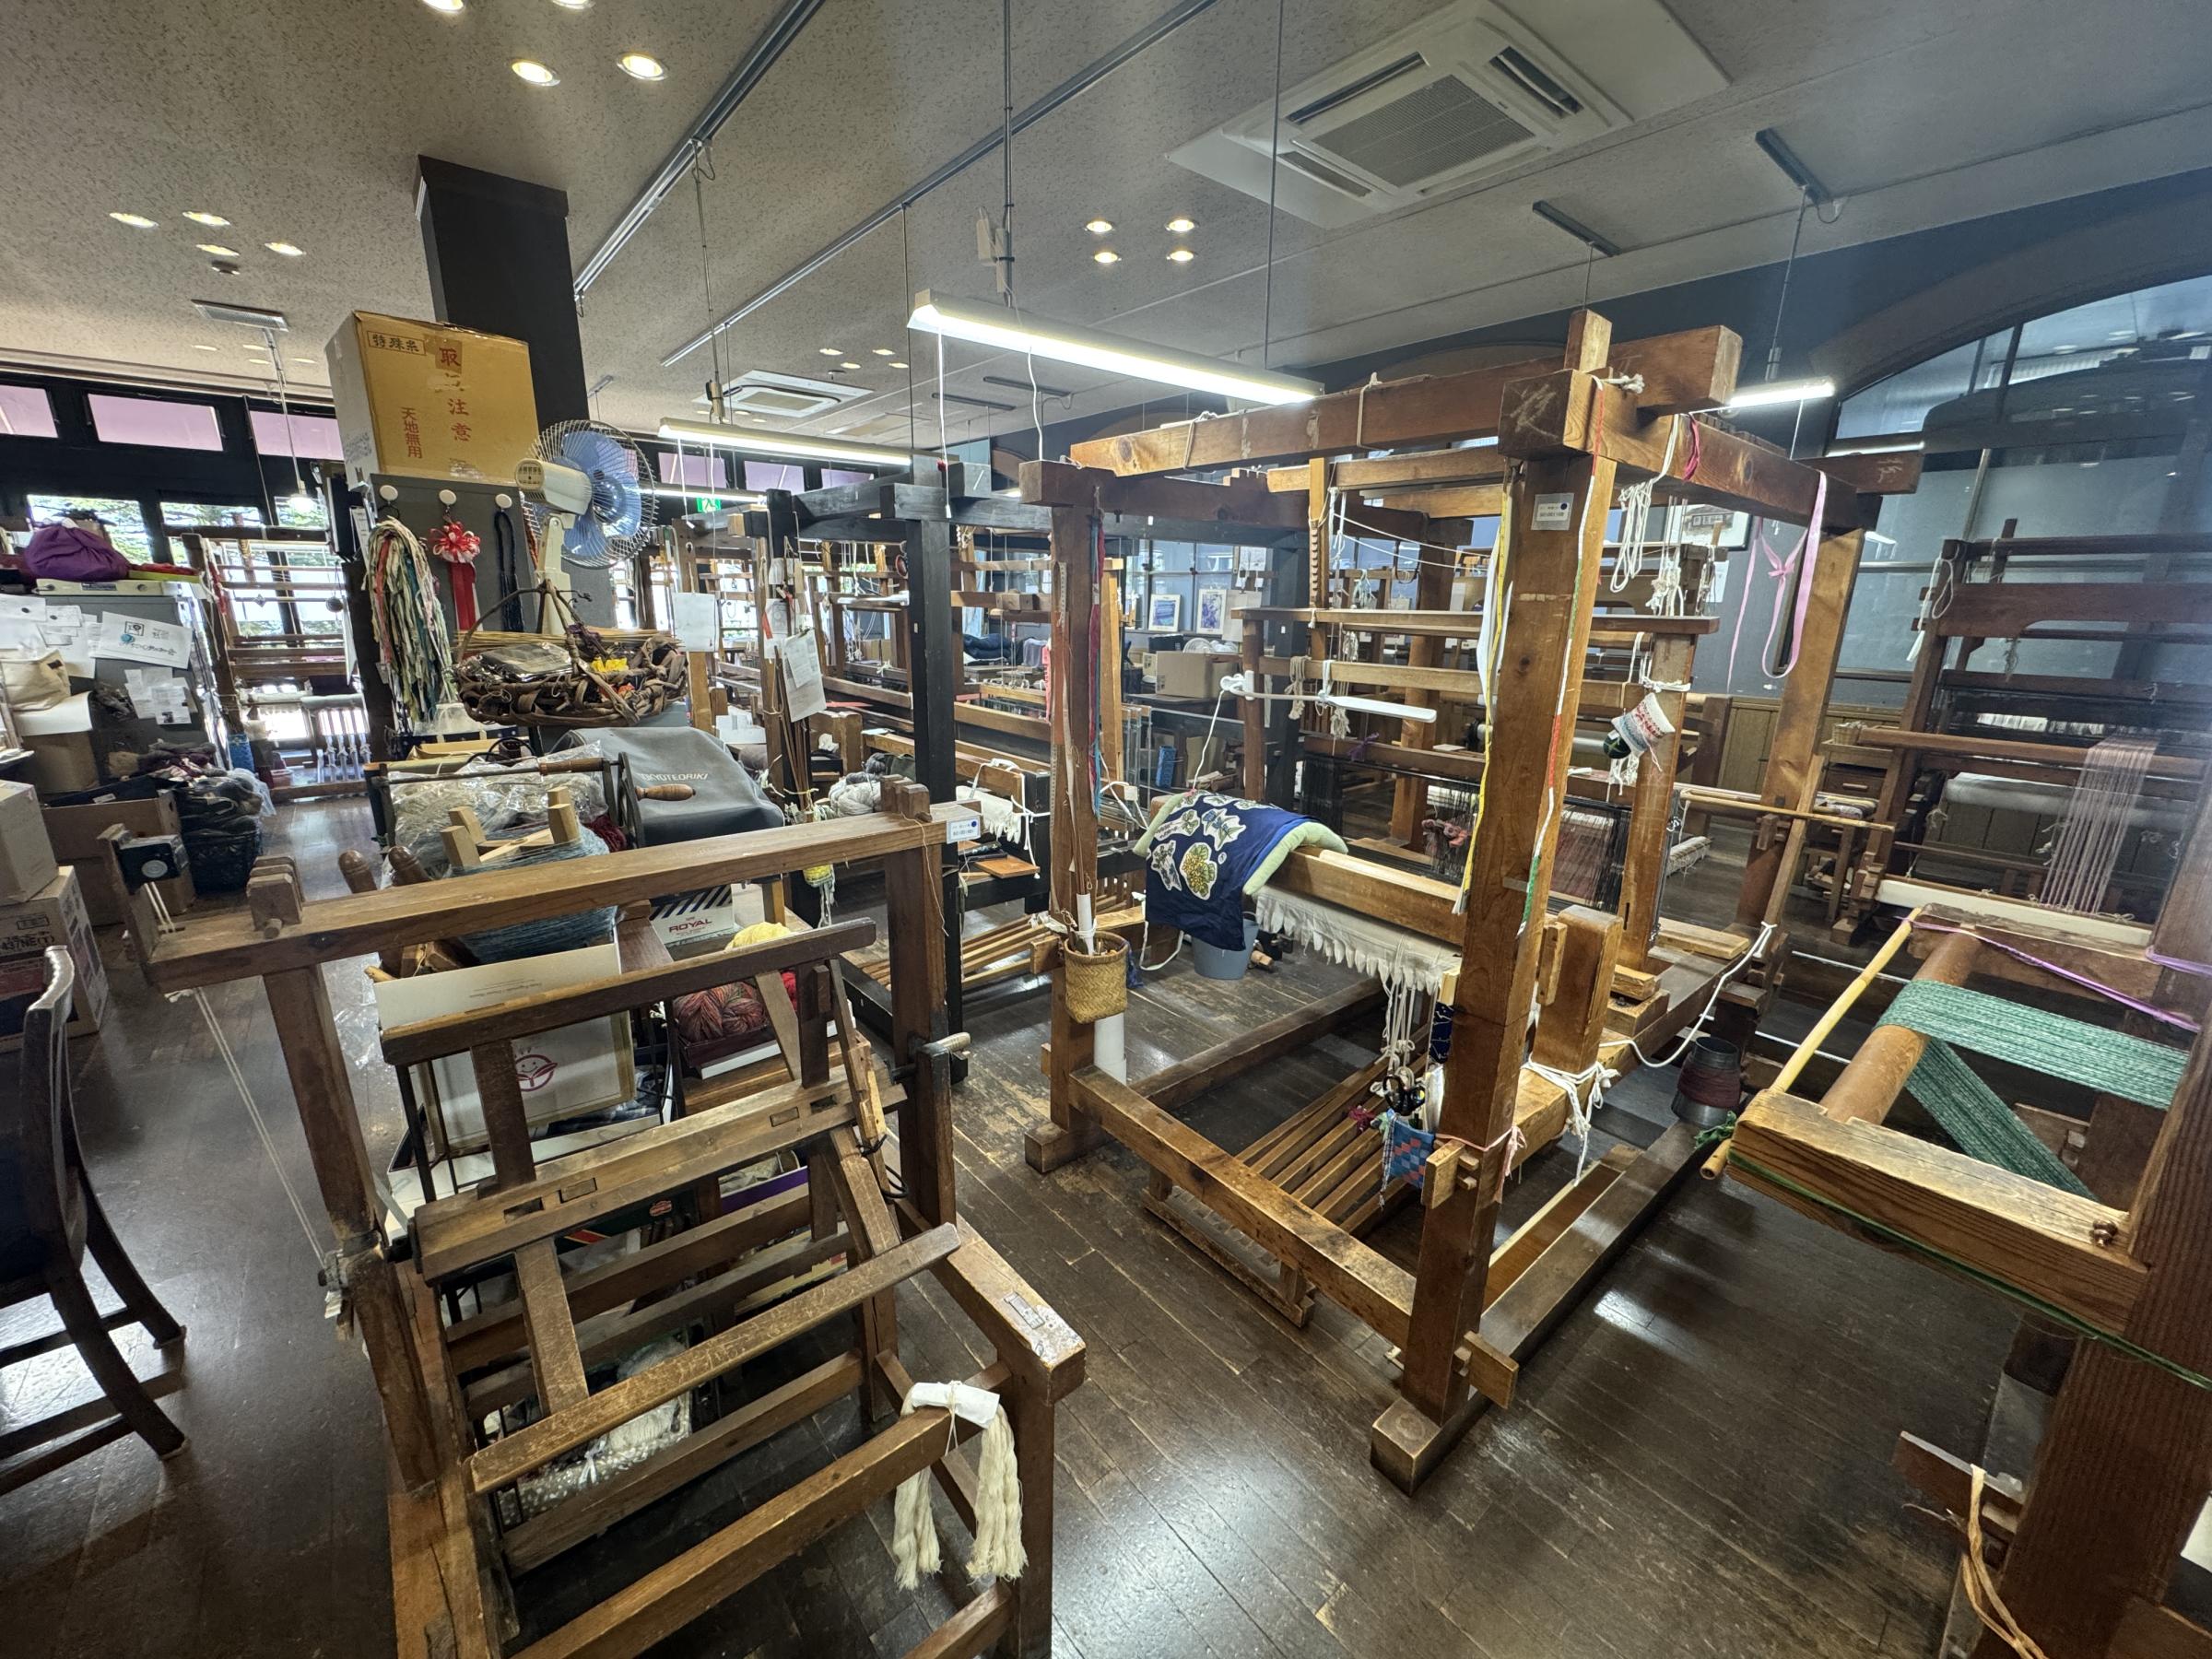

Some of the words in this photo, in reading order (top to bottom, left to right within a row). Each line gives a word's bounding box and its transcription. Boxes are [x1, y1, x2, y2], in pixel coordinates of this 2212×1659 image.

[438, 347, 473, 442] 取注意
[400, 406, 423, 459] 天地無用
[669, 918, 712, 933] ROYAL
